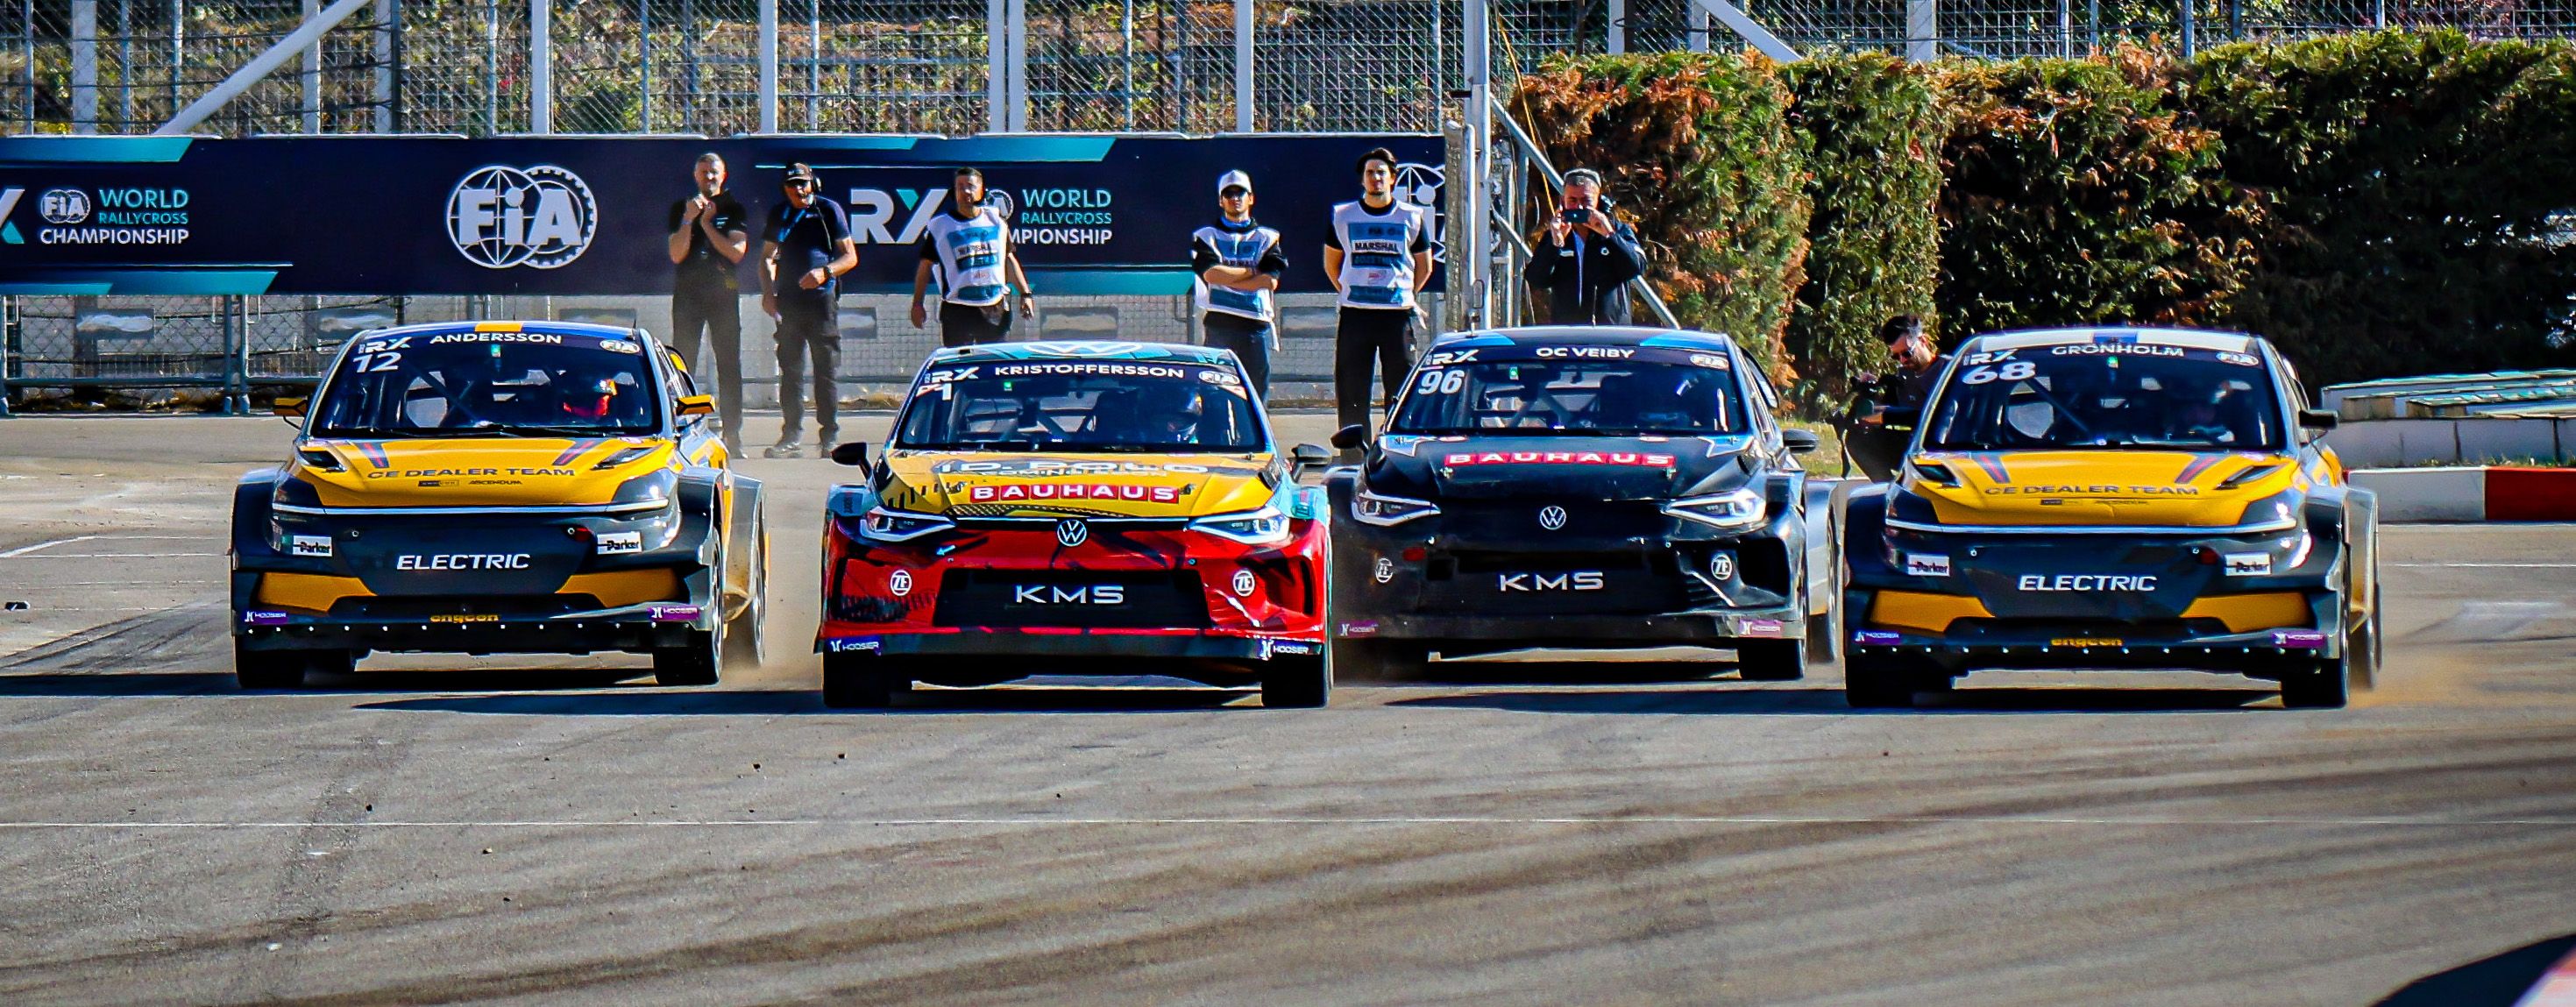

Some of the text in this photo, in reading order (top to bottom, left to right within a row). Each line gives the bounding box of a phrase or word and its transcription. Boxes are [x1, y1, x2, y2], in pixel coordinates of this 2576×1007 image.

[99, 189, 188, 208] WORLD
[1022, 188, 1111, 208] WORLD
[99, 213, 188, 224] RALLYCROSS
[1022, 212, 1111, 224] RALLYCROSS
[40, 229, 189, 245] CHAMPIONSHIP
[1010, 228, 1112, 245] MPIONSHIP
[429, 333, 562, 344] ANDERSSON
[1536, 347, 1635, 358] OC VEIBY
[353, 352, 402, 373] 12
[995, 365, 1184, 379] KRISTOFFERSSON
[1962, 361, 2037, 385] 68
[1418, 370, 1465, 395] 96
[1449, 452, 1674, 464] BAUHAUS
[406, 469, 498, 478] DEALER
[507, 468, 575, 477] TEAM
[974, 485, 1174, 500] BAUHAUS
[1985, 485, 2199, 495] CE DEALER TEAM
[299, 541, 331, 554] Parker
[606, 540, 640, 552] Parker
[396, 554, 531, 570] ELECTRIC
[1500, 572, 1604, 592] KMS
[2019, 575, 2158, 592] ELECTRIC
[1016, 585, 1125, 604] KMS
[430, 614, 499, 623] engcon
